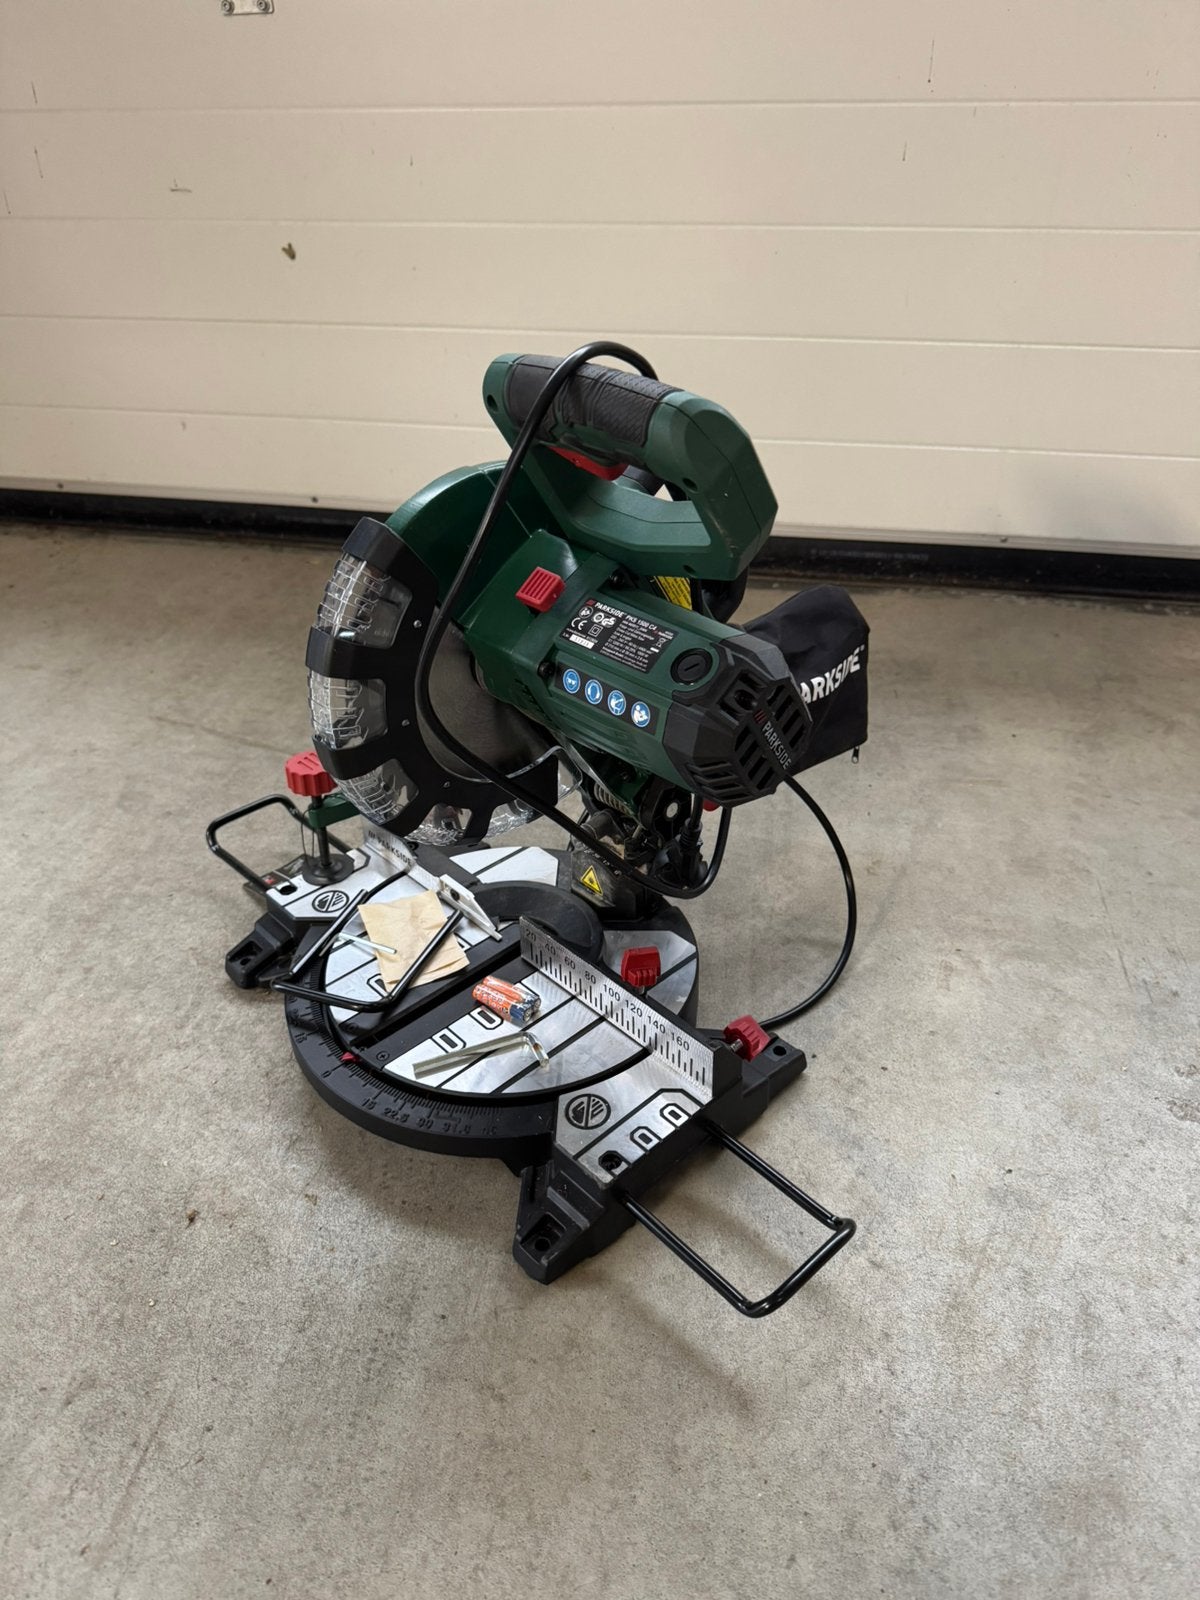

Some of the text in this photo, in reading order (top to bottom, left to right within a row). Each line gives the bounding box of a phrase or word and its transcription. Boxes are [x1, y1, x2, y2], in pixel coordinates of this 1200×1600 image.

[594, 602, 624, 618] PARKSIDE
[800, 647, 861, 704] ARKSIDE
[762, 720, 792, 770] PARKSIDE
[525, 929, 690, 1051] 20 40 60 80 100 120 140 160
